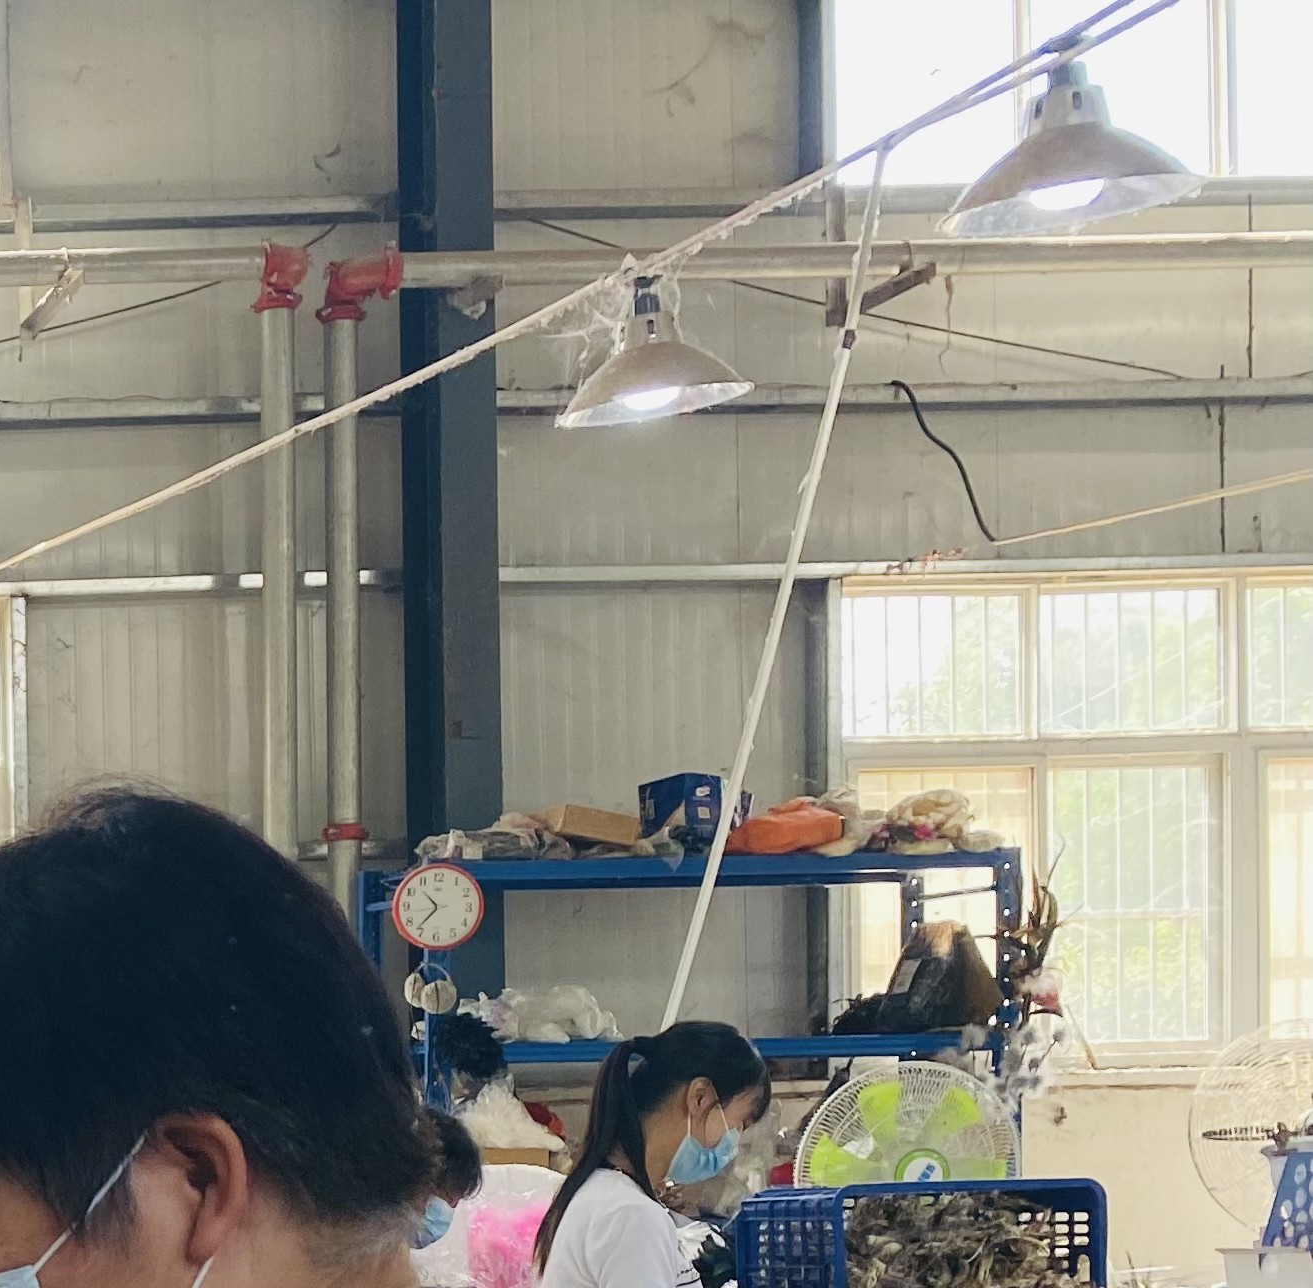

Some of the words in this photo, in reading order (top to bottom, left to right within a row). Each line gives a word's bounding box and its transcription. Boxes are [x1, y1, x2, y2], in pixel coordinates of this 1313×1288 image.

[419, 877, 427, 887] 11
[434, 872, 445, 883] 12
[406, 888, 416, 897] 10
[462, 888, 470, 898] 2
[402, 901, 411, 912] 9
[464, 902, 473, 913] 3
[405, 917, 414, 927] 8
[461, 918, 468, 928] 4
[416, 927, 425, 938] 7
[432, 931, 441, 942] 6
[449, 928, 457, 938] 5
